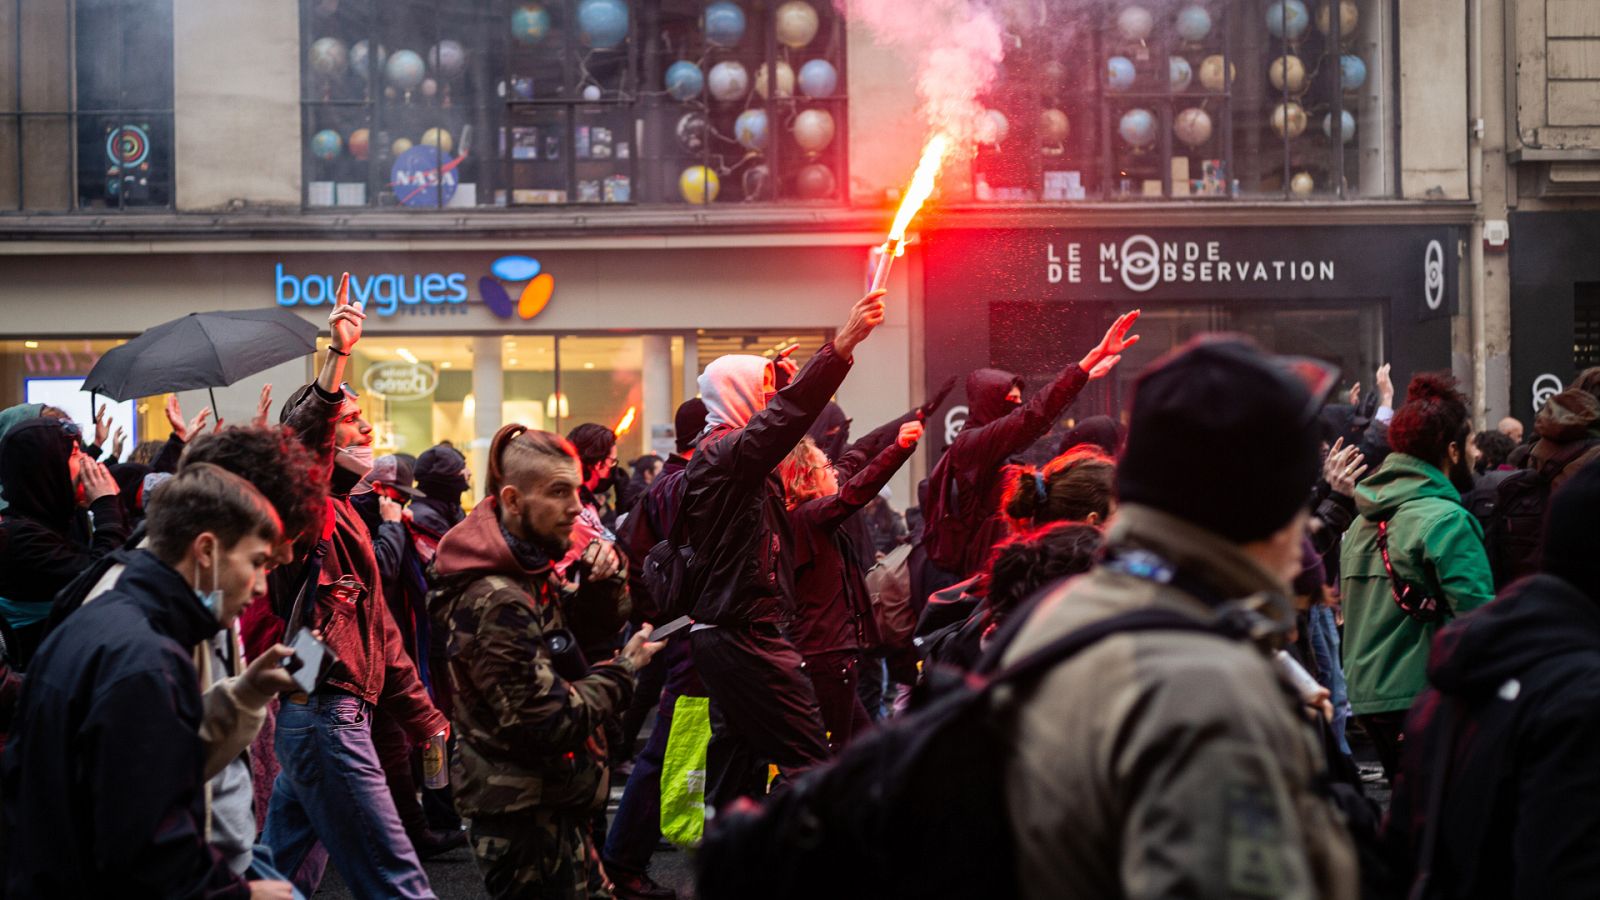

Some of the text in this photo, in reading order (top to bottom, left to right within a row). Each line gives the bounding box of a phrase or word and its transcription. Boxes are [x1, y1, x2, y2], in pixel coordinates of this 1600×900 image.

[396, 169, 455, 187] NASA
[1047, 235, 1221, 275] LE MONDE
[1047, 263, 1082, 283] DE
